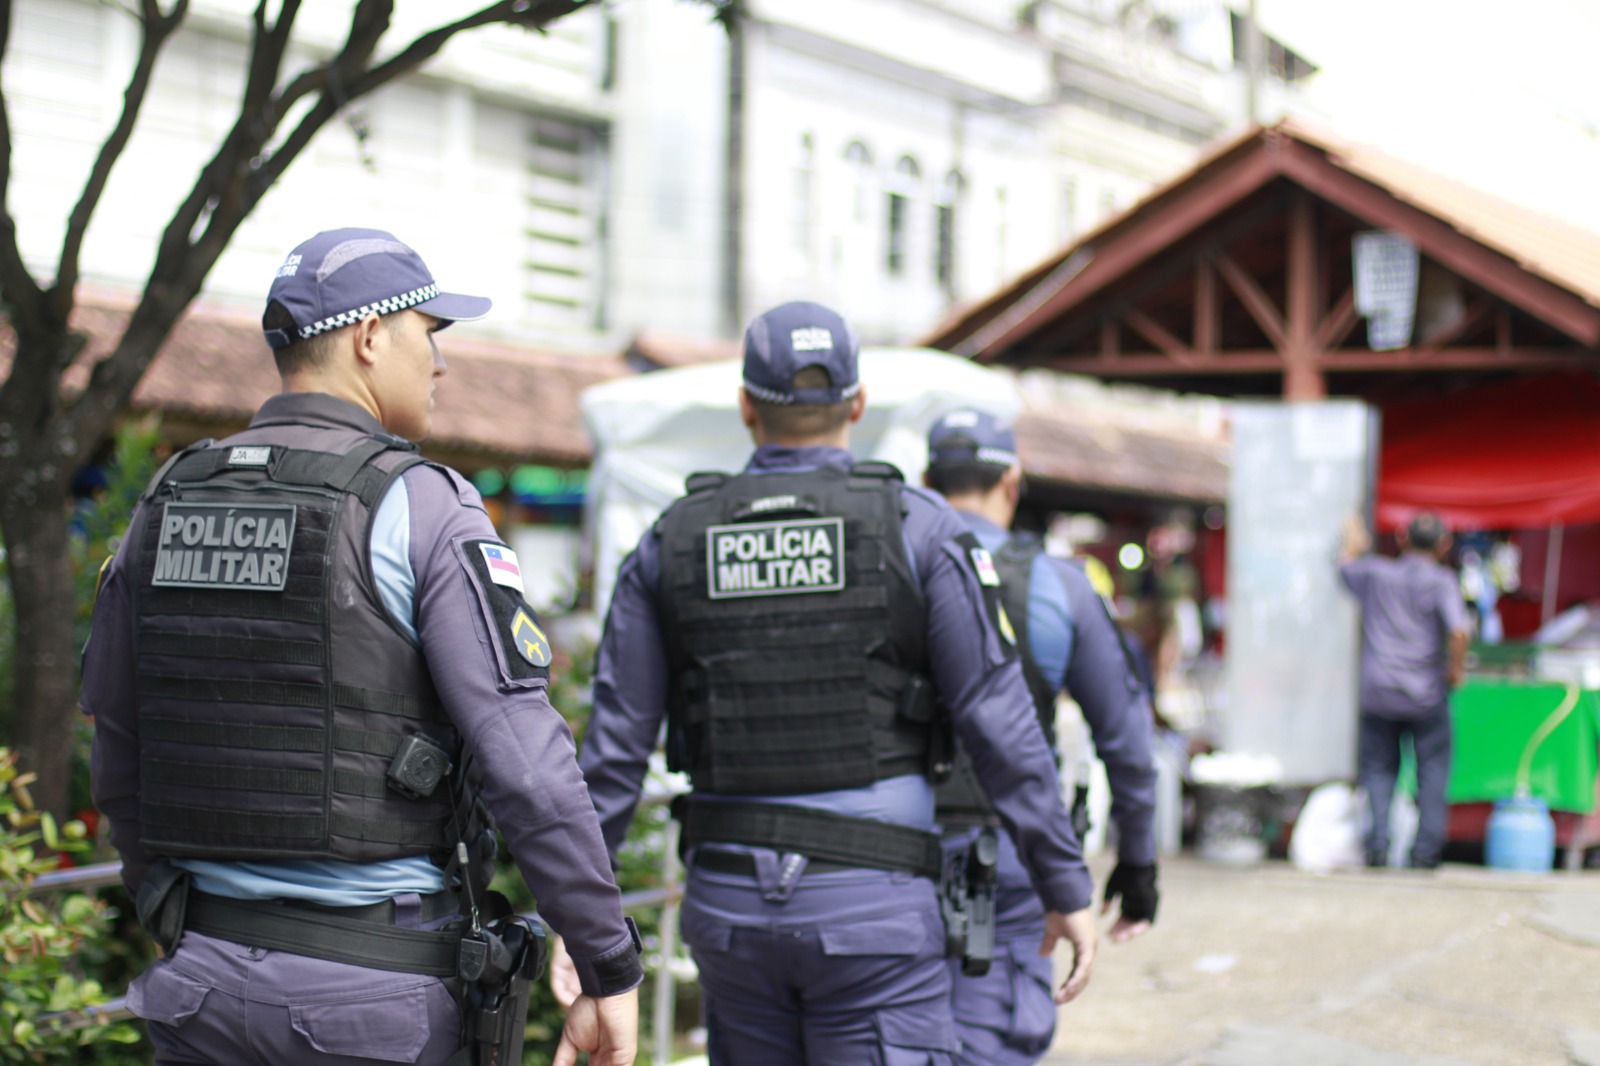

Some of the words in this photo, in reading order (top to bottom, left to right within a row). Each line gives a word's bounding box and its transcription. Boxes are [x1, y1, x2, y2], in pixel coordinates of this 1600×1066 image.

[162, 509, 287, 549] POLÍCIA
[718, 526, 833, 562] POLÍCIA
[156, 550, 284, 585] MILITAR
[720, 557, 834, 590] MILITAR
